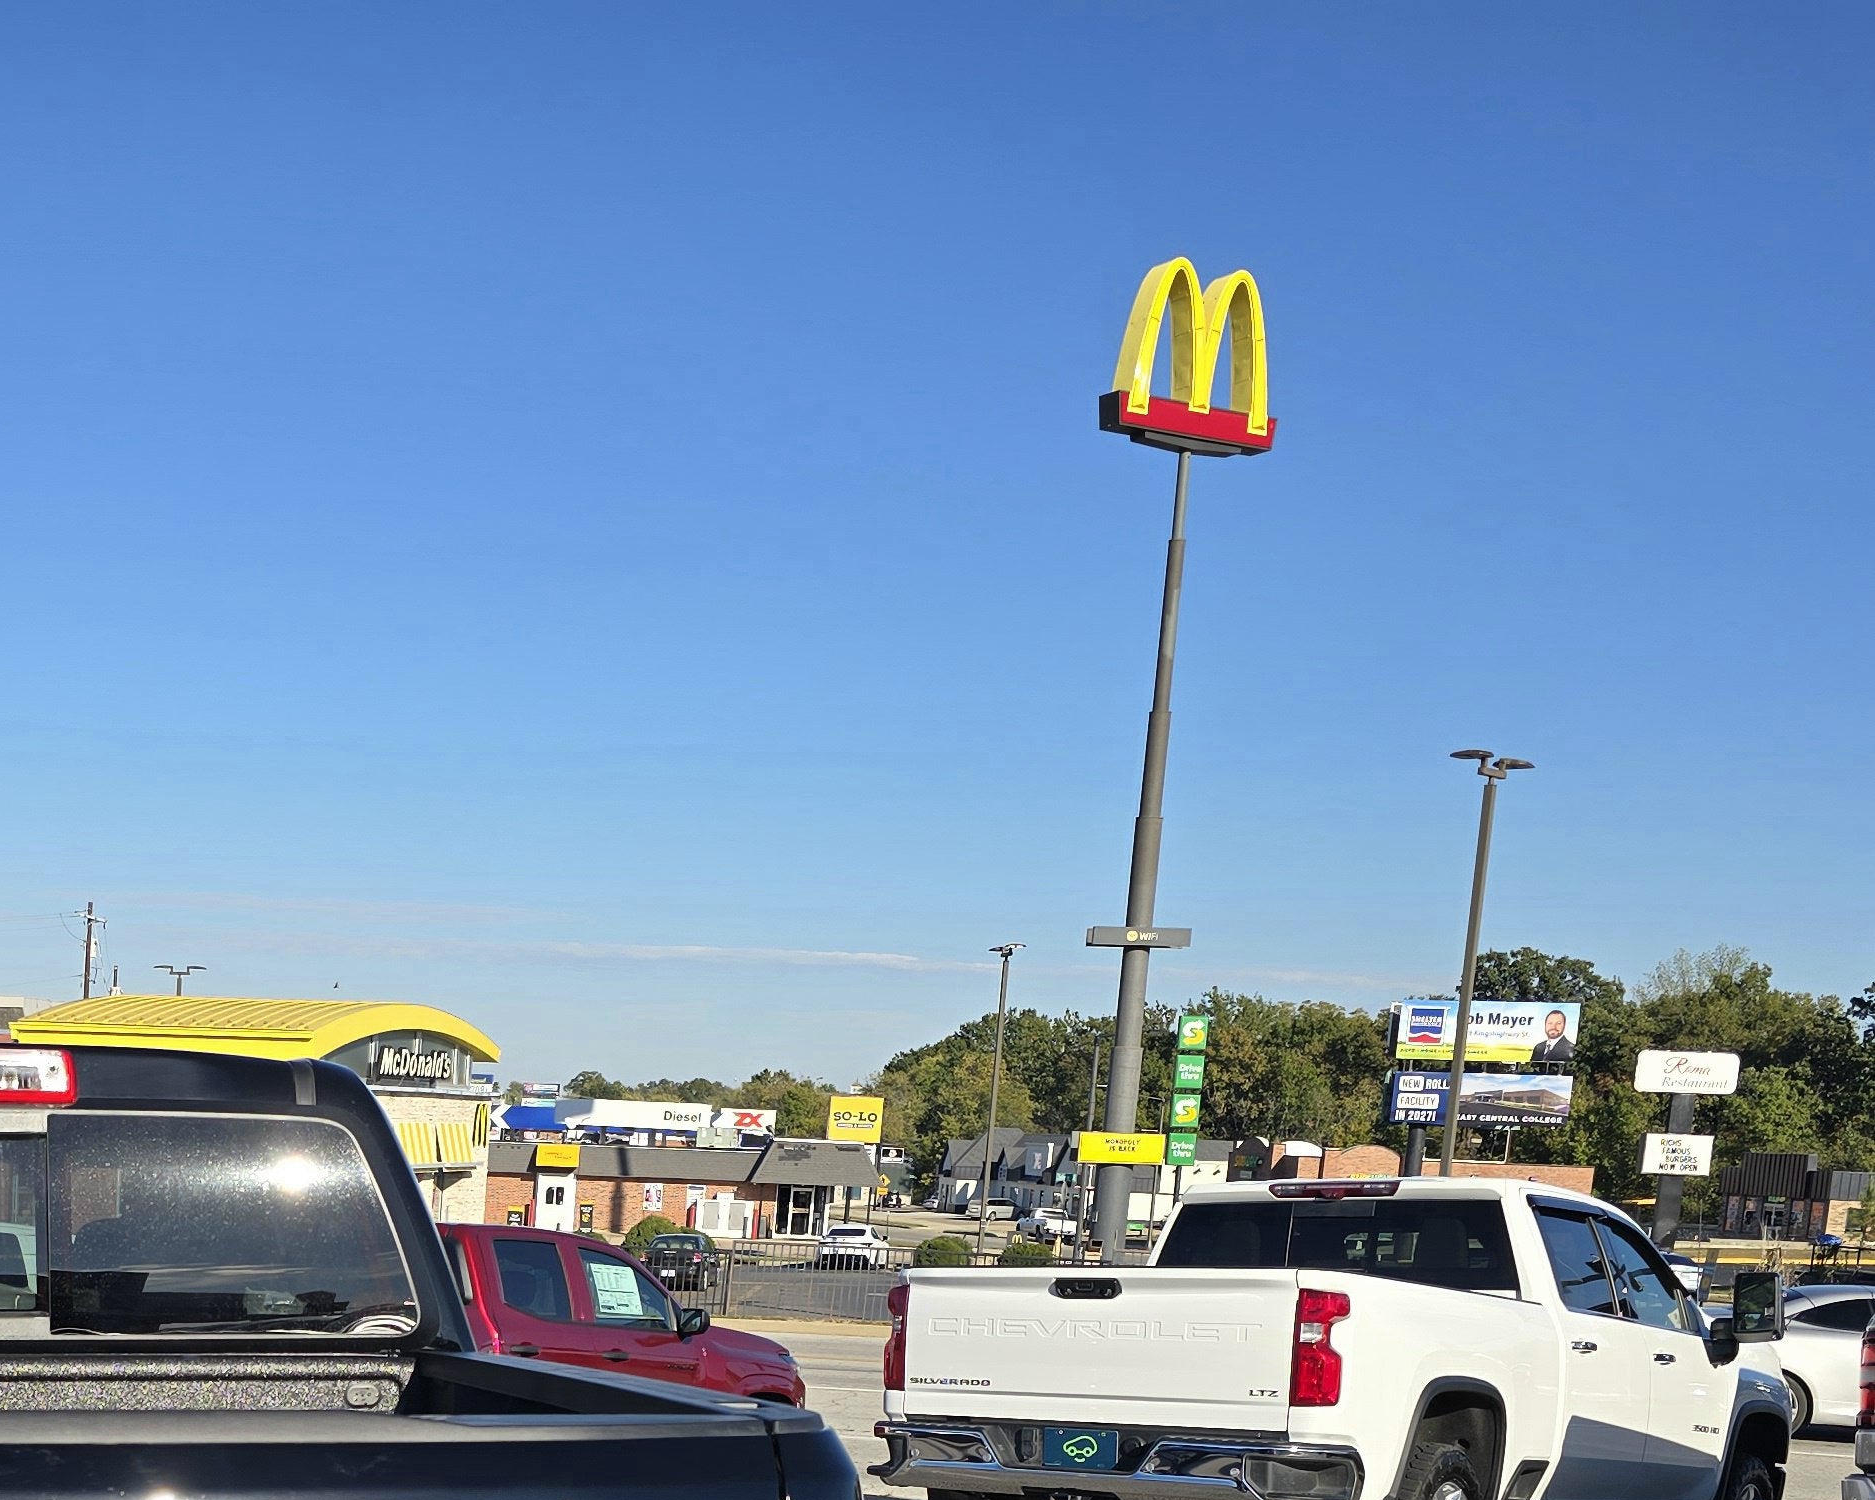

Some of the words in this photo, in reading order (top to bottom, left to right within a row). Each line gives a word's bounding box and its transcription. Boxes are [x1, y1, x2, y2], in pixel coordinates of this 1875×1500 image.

[1467, 1013, 1484, 1026] ob
[1488, 1013, 1534, 1028] Mayer
[379, 1047, 452, 1079] McDonald's
[1178, 1063, 1203, 1073] Drive
[1181, 1072, 1200, 1080] thru
[1402, 1078, 1421, 1089] NEW
[1661, 1077, 1728, 1089] Restaurant
[1400, 1096, 1436, 1106] FACILITY
[663, 1110, 702, 1123] Diesel
[833, 1110, 878, 1123] SO-LO
[1395, 1110, 1406, 1121] IN
[1479, 1114, 1519, 1123] CENTRAL
[1521, 1115, 1563, 1124] COLLEGE
[1105, 1138, 1141, 1146] MONOPOLY
[1171, 1141, 1195, 1150] Drive
[1172, 1149, 1192, 1158] thru
[1662, 1147, 1691, 1156] FAMOUS
[1665, 1155, 1698, 1164] BURGERS
[1658, 1163, 1676, 1171] NOW
[1679, 1163, 1698, 1172] OPEN
[927, 1316, 1263, 1344] CHEVROLET
[909, 1376, 991, 1387] SILVERADO
[1248, 1389, 1279, 1398] LTZ
